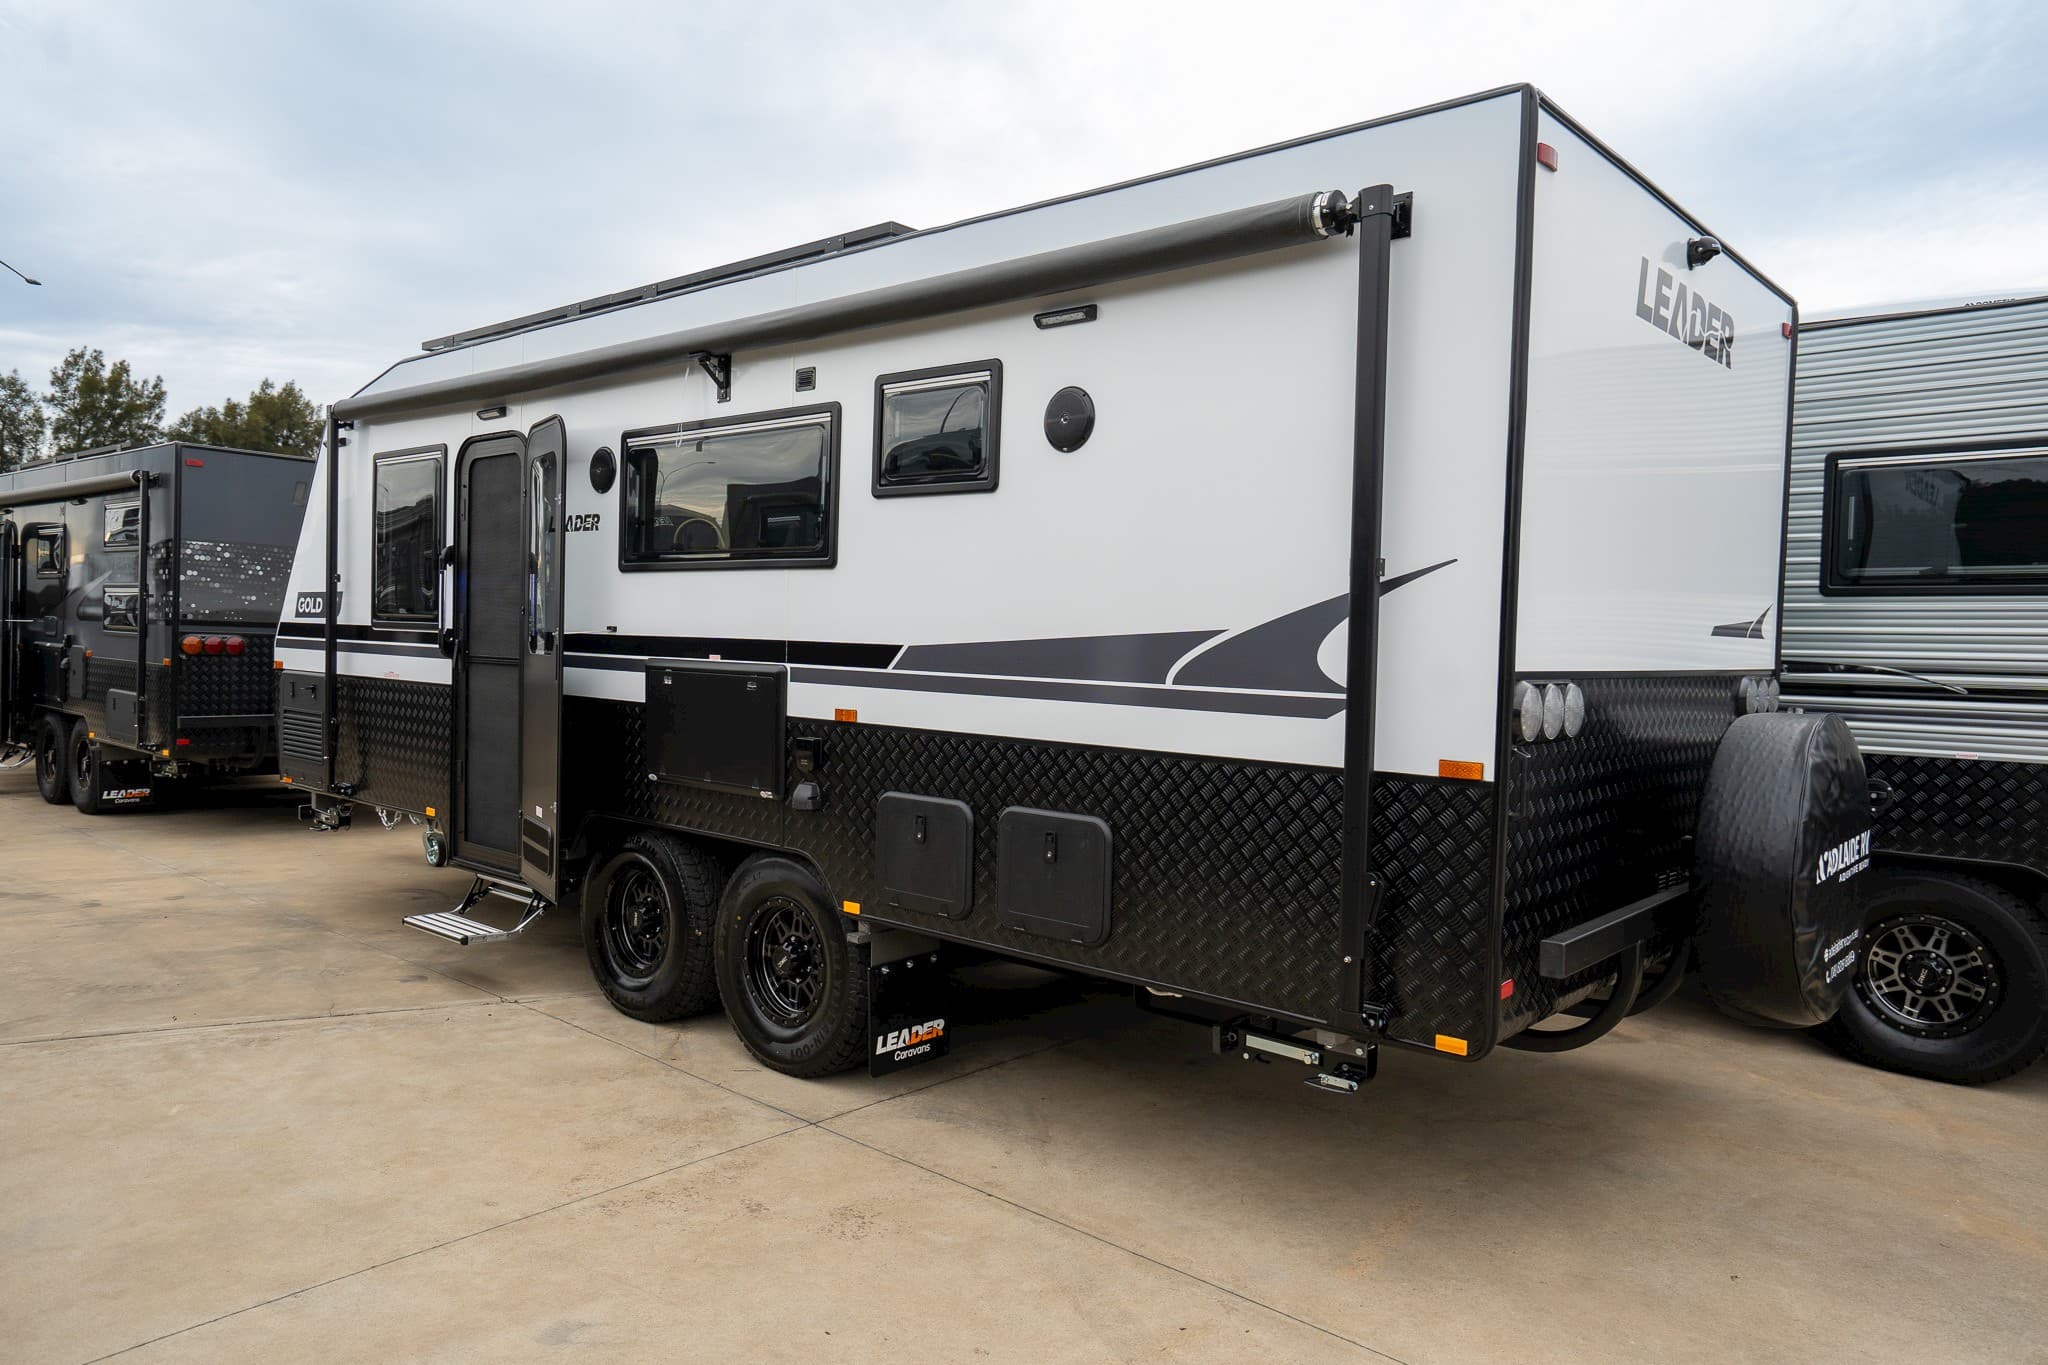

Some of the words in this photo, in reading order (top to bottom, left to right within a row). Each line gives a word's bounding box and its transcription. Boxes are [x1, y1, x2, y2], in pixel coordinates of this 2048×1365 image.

[1636, 255, 1734, 370] LEADER
[548, 513, 601, 533] LADER
[297, 597, 324, 613] GOLD
[101, 788, 151, 800] LEADER
[875, 1018, 945, 1056] LEADER
[894, 1043, 932, 1061] Caravans
